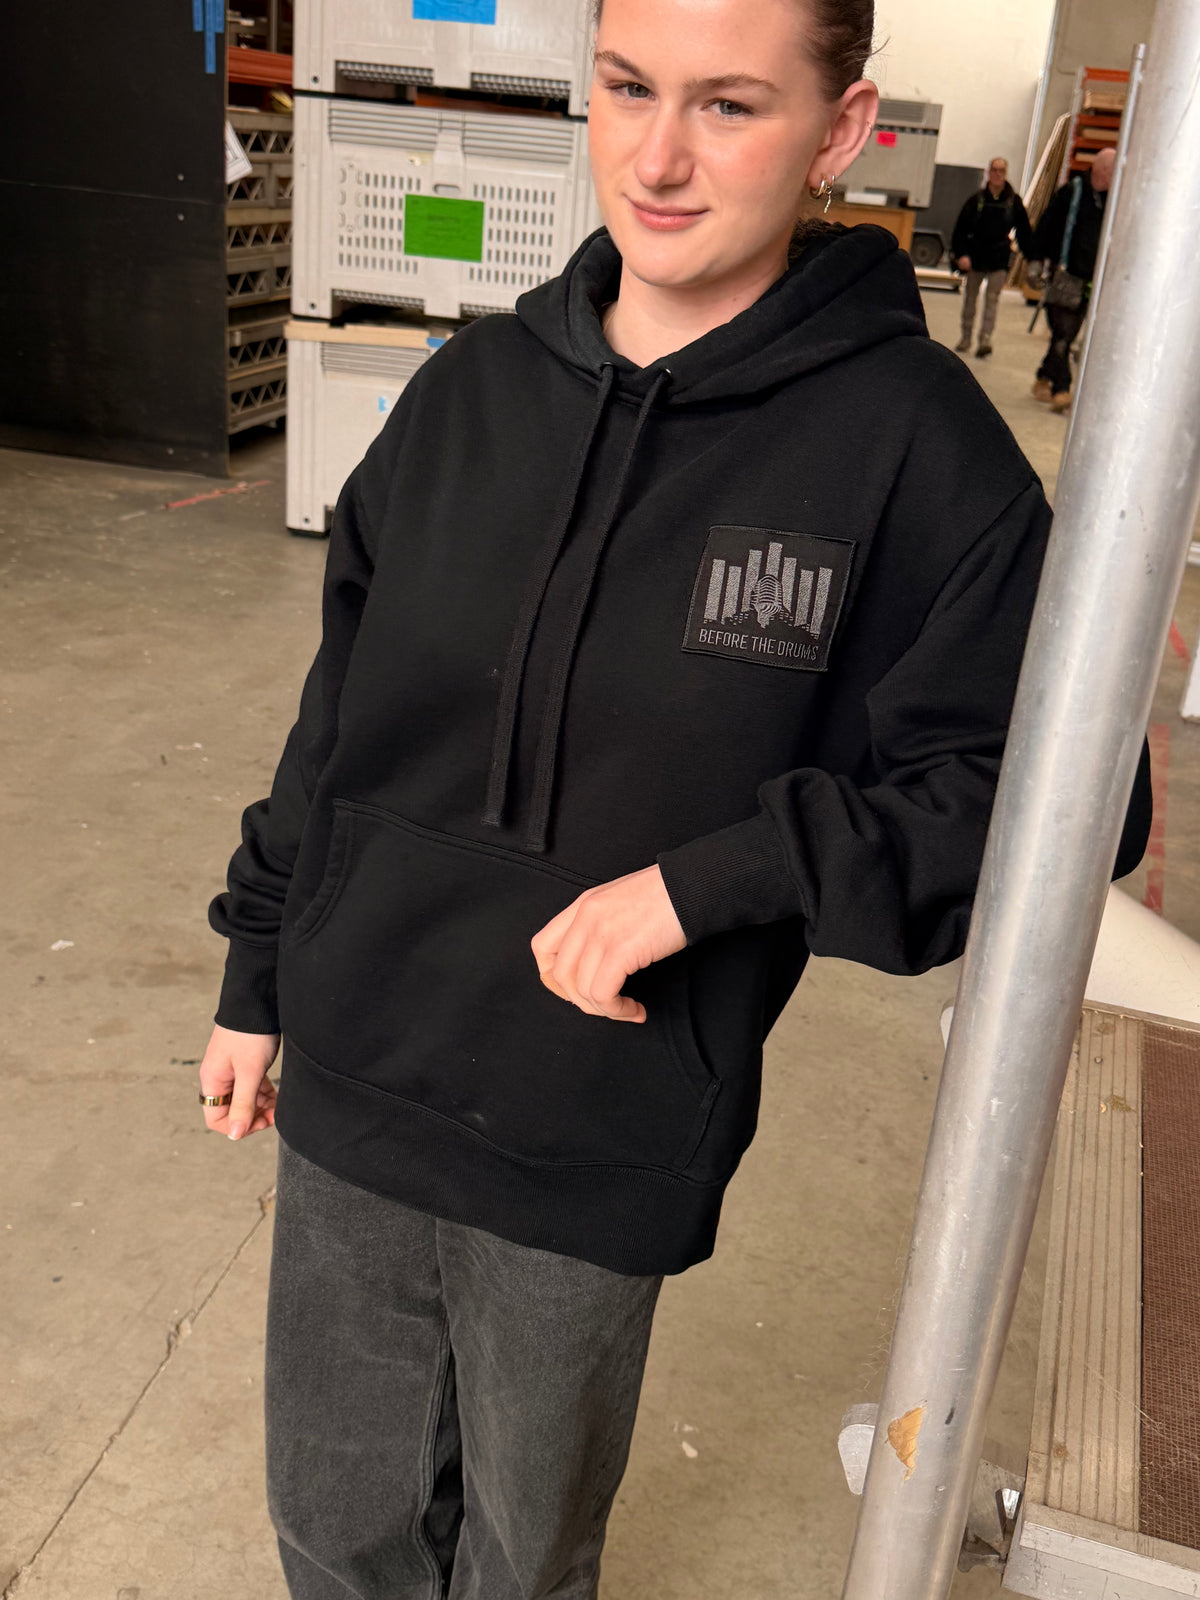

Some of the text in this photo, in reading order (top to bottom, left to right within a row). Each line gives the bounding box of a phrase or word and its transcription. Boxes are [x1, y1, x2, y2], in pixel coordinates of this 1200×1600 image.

[699, 629, 819, 661] BEFORE THE DRUMS
